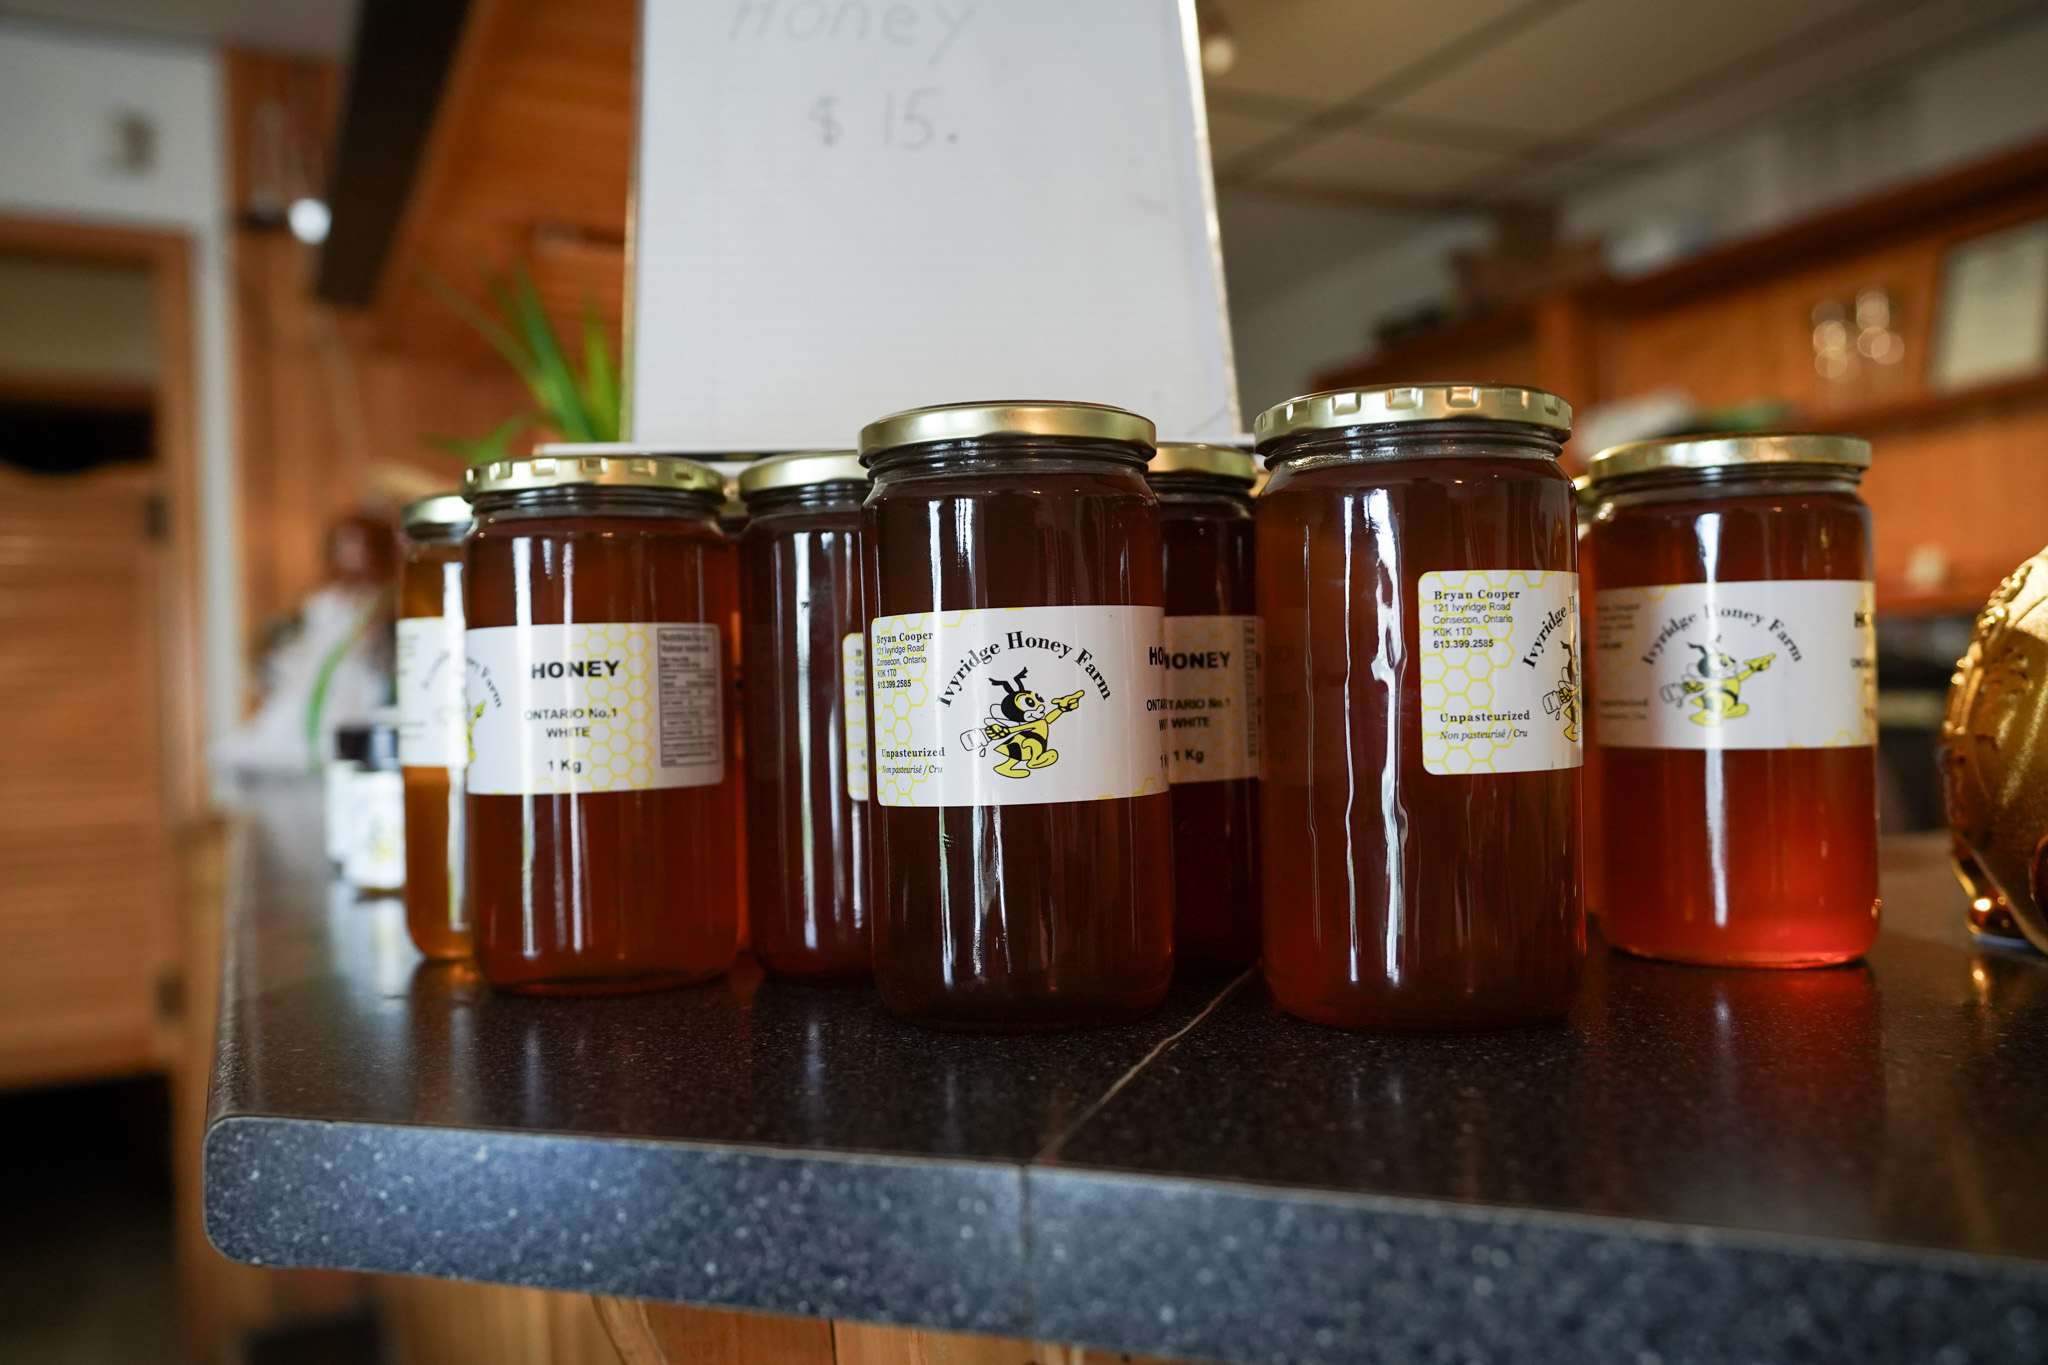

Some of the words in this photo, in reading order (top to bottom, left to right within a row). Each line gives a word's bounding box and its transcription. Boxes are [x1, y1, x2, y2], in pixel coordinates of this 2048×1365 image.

[807, 92, 846, 149] $
[1434, 590, 1473, 601] Bryan
[1477, 589, 1520, 600] Cooper
[1432, 603, 1449, 612] 121
[1452, 602, 1487, 613] Ivyridge
[1489, 601, 1511, 611] Road
[1432, 615, 1480, 625] Consecon,
[1483, 614, 1513, 623] Ontario
[876, 634, 897, 645] Bryan
[899, 632, 933, 643] Cooper
[1433, 639, 1494, 649] 613.399.2585
[1522, 606, 1567, 669] Ivyridge
[1641, 613, 1697, 665] Ivyridge
[1768, 618, 1802, 662] Farm
[876, 647, 884, 655] 121
[885, 645, 906, 656] Ivyridge
[907, 643, 925, 653] Road
[903, 655, 927, 665] Ontario
[531, 660, 619, 679] HONEY
[937, 643, 1001, 708] Ivyridge
[1005, 630, 1073, 659] Honey
[1074, 647, 1111, 701] Farm
[877, 679, 912, 689] 613.399.2585
[525, 708, 584, 720] ONTARIO
[588, 707, 617, 718] No.1
[1440, 710, 1530, 724] Unpasteurized
[1171, 716, 1209, 729] WHITE
[545, 726, 590, 738] WHITE
[1439, 731, 1459, 740] Non
[1461, 728, 1506, 741] pasteurisé
[1513, 728, 1528, 738] Cru
[881, 747, 946, 760] Unpasteurized
[1173, 750, 1180, 761] 1
[1184, 749, 1204, 763] Kg
[547, 760, 554, 771] 1
[560, 759, 582, 773] Kg
[928, 764, 943, 774] Cru
